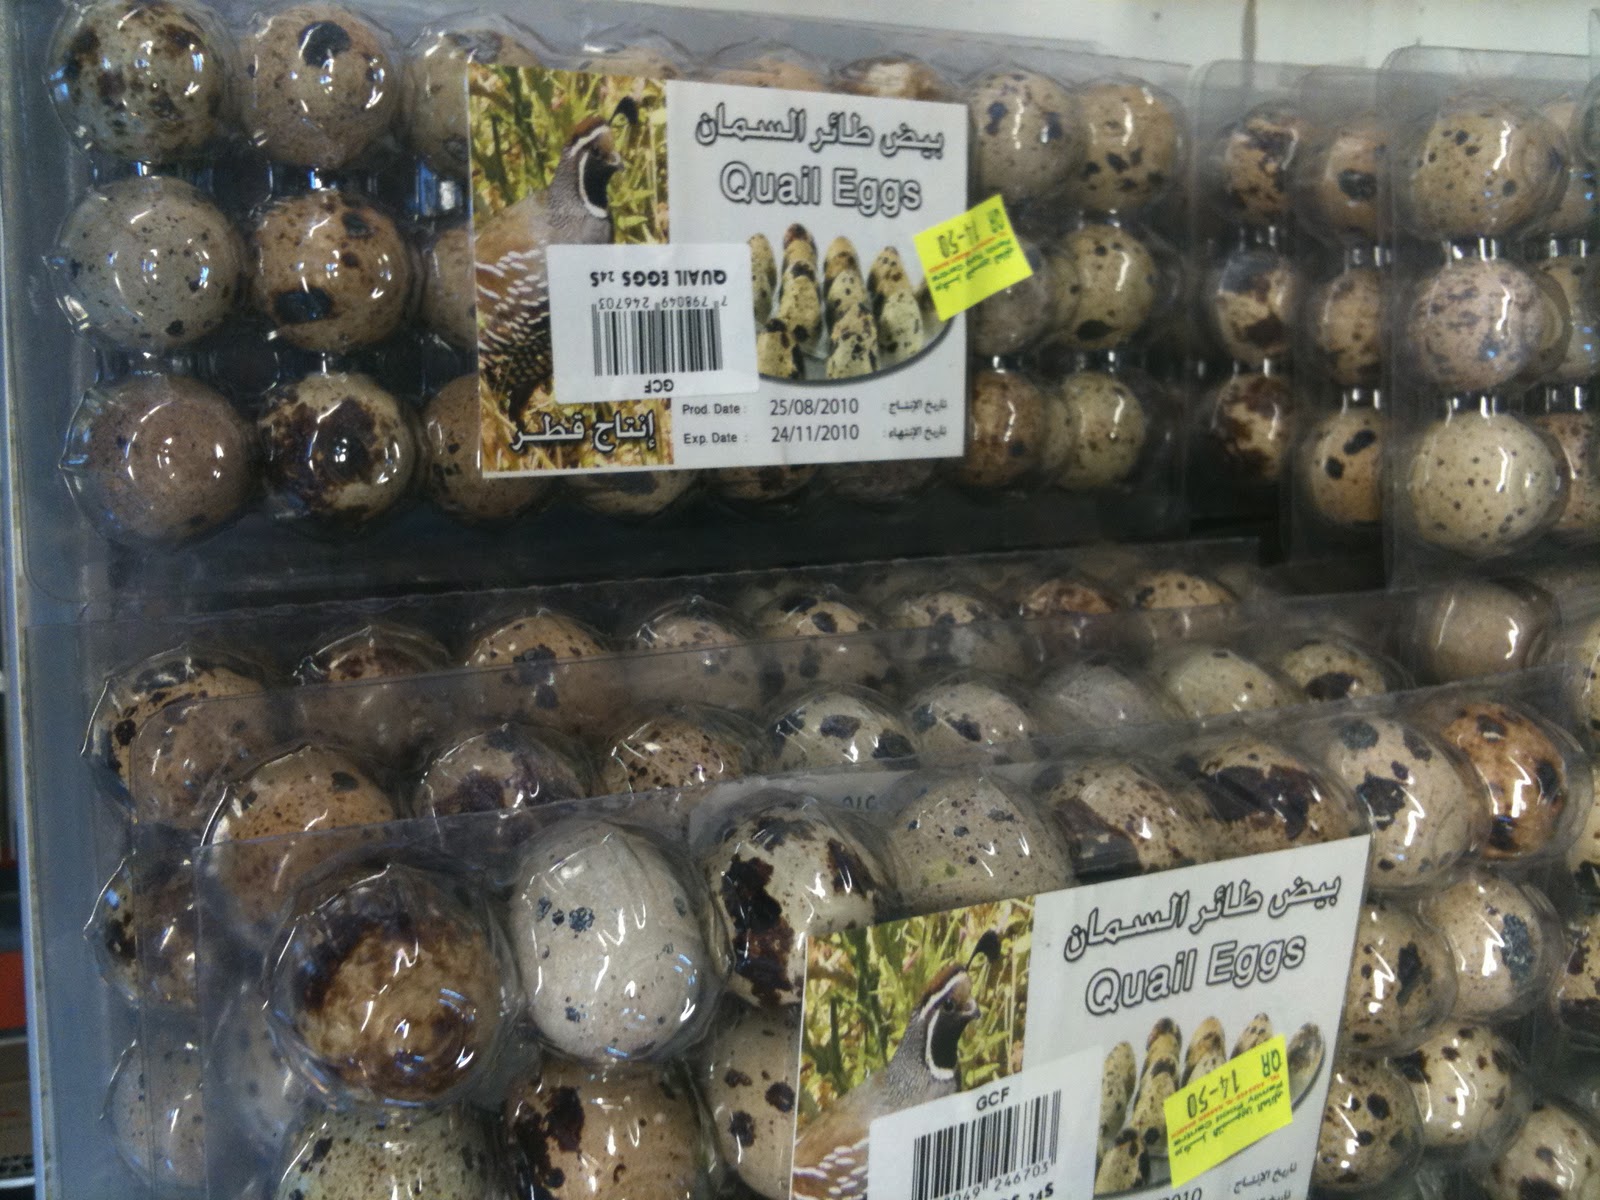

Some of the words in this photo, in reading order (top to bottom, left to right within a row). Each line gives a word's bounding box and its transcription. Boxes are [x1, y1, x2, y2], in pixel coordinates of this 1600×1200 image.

[696, 102, 806, 146] السمان
[809, 112, 875, 153] طائر
[880, 123, 945, 160] بيض
[719, 161, 821, 205] Quail
[832, 168, 922, 217] Eggs
[622, 270, 669, 286] EGGS
[675, 270, 727, 286] QUAIL
[598, 297, 650, 310] 246703
[661, 295, 709, 309] 798049
[644, 379, 675, 394] GCF
[682, 402, 708, 416] Prod.
[714, 402, 741, 416] Date
[770, 397, 859, 417] 25/08/2010
[510, 411, 585, 454] قطر
[592, 409, 657, 453] إنتاج
[683, 432, 708, 446] Exp.
[711, 431, 738, 444] Date
[771, 424, 859, 444] 24/11/2010
[1189, 879, 1263, 934] طائر
[1268, 876, 1342, 918] بيض
[1063, 890, 1190, 963] السمان
[1085, 949, 1198, 1016] Quail
[1206, 935, 1306, 988] Eggs
[1261, 1049, 1282, 1077] QR
[976, 1086, 1011, 1112] GCF
[1187, 1069, 1240, 1118] 14-50
[994, 1161, 1049, 1192] 246703
